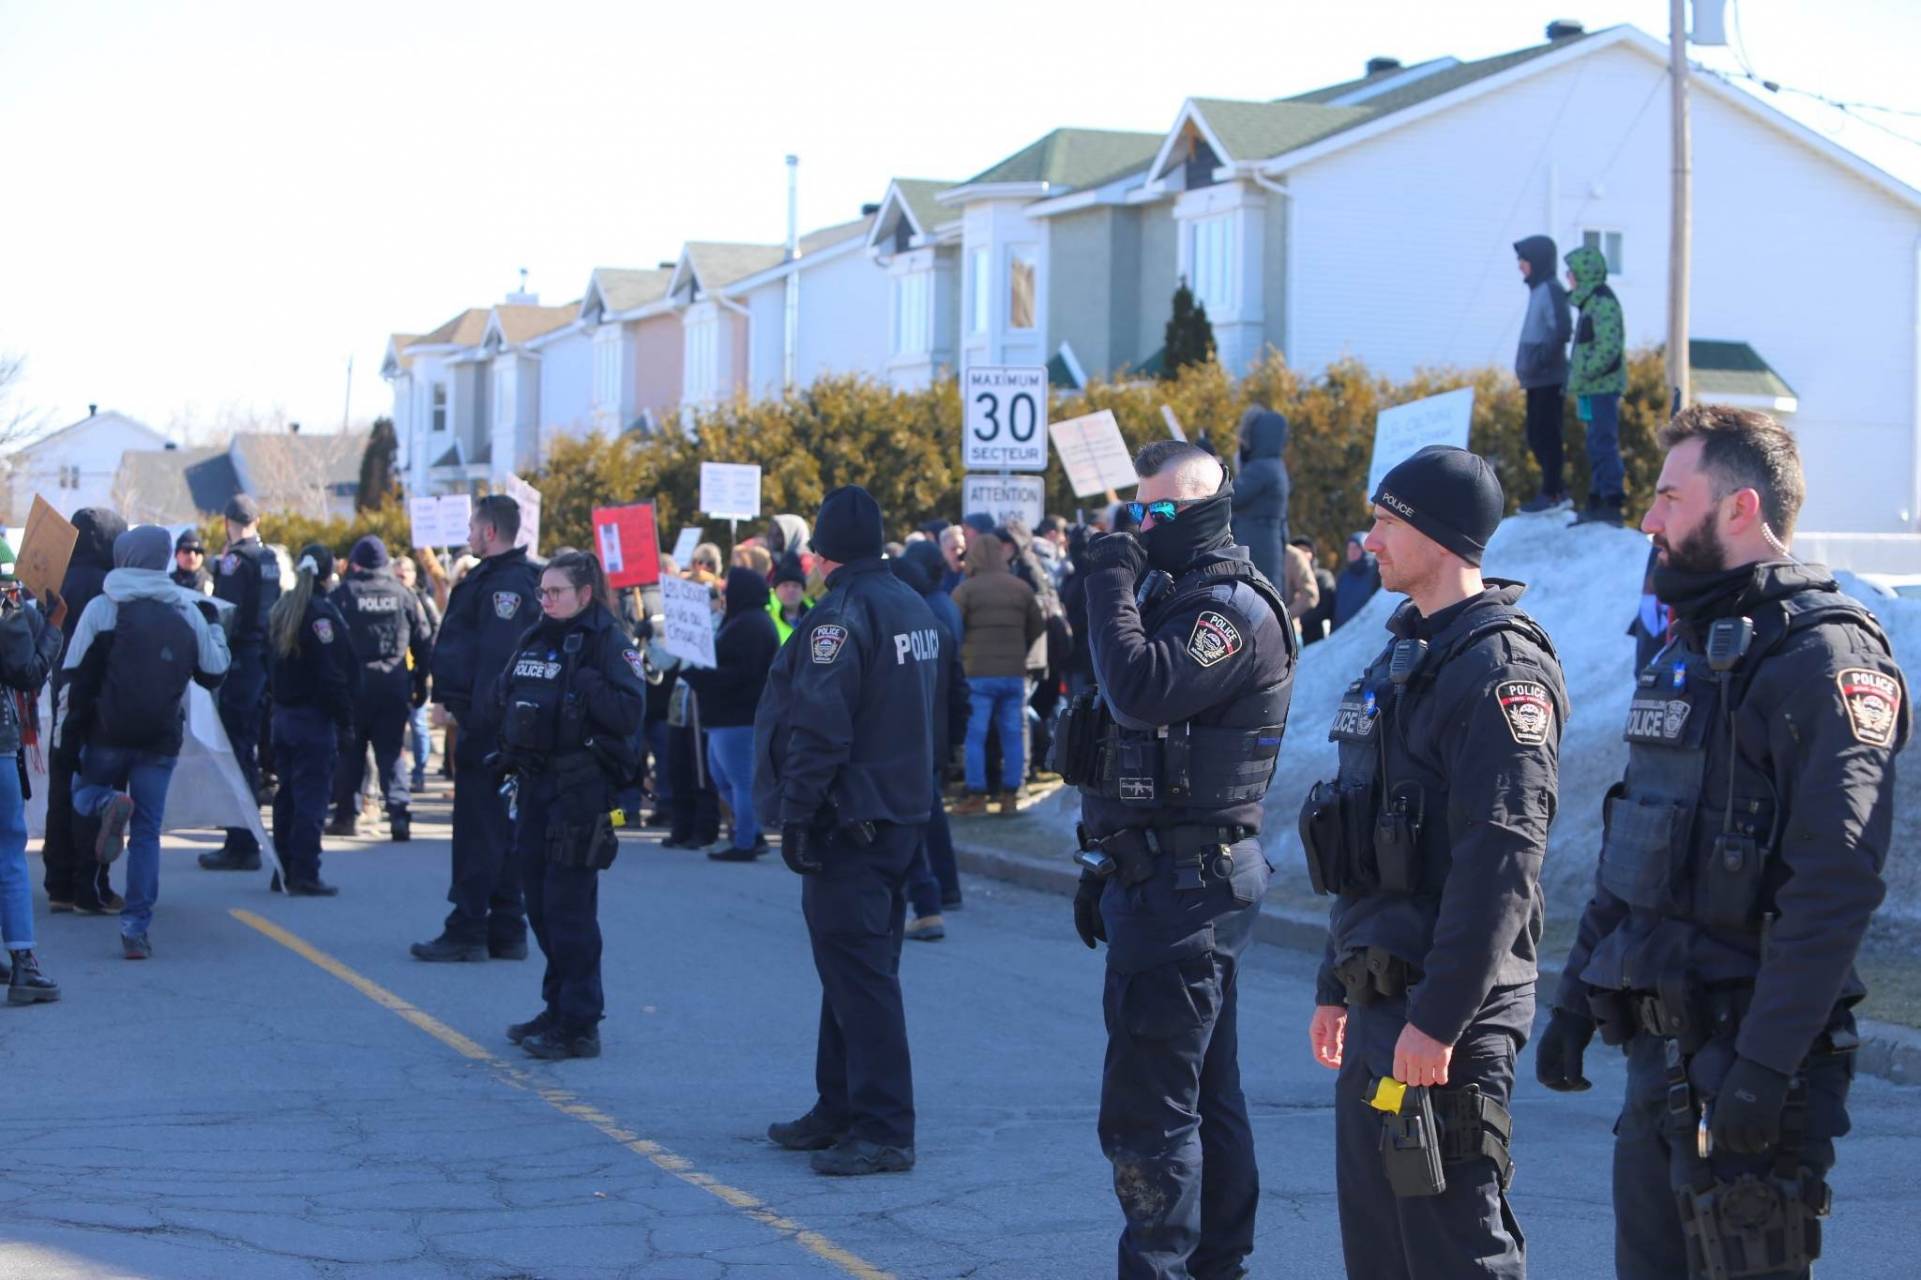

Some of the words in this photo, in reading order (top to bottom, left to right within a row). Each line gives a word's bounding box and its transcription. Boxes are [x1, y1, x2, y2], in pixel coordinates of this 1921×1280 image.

[971, 374, 1039, 387] MAXIMUM
[973, 391, 1037, 442] 30
[971, 447, 1039, 460] SECTEUR
[970, 486, 1038, 501] ATTENTION
[1382, 492, 1415, 517] POLICE
[358, 596, 398, 611] POLICE
[817, 627, 840, 637] POLICE
[1210, 615, 1238, 643] POLICE
[893, 628, 940, 665] POLIC
[1508, 684, 1546, 701] POLICE
[1851, 672, 1894, 696] POLICE
[1626, 709, 1664, 737] OLICE
